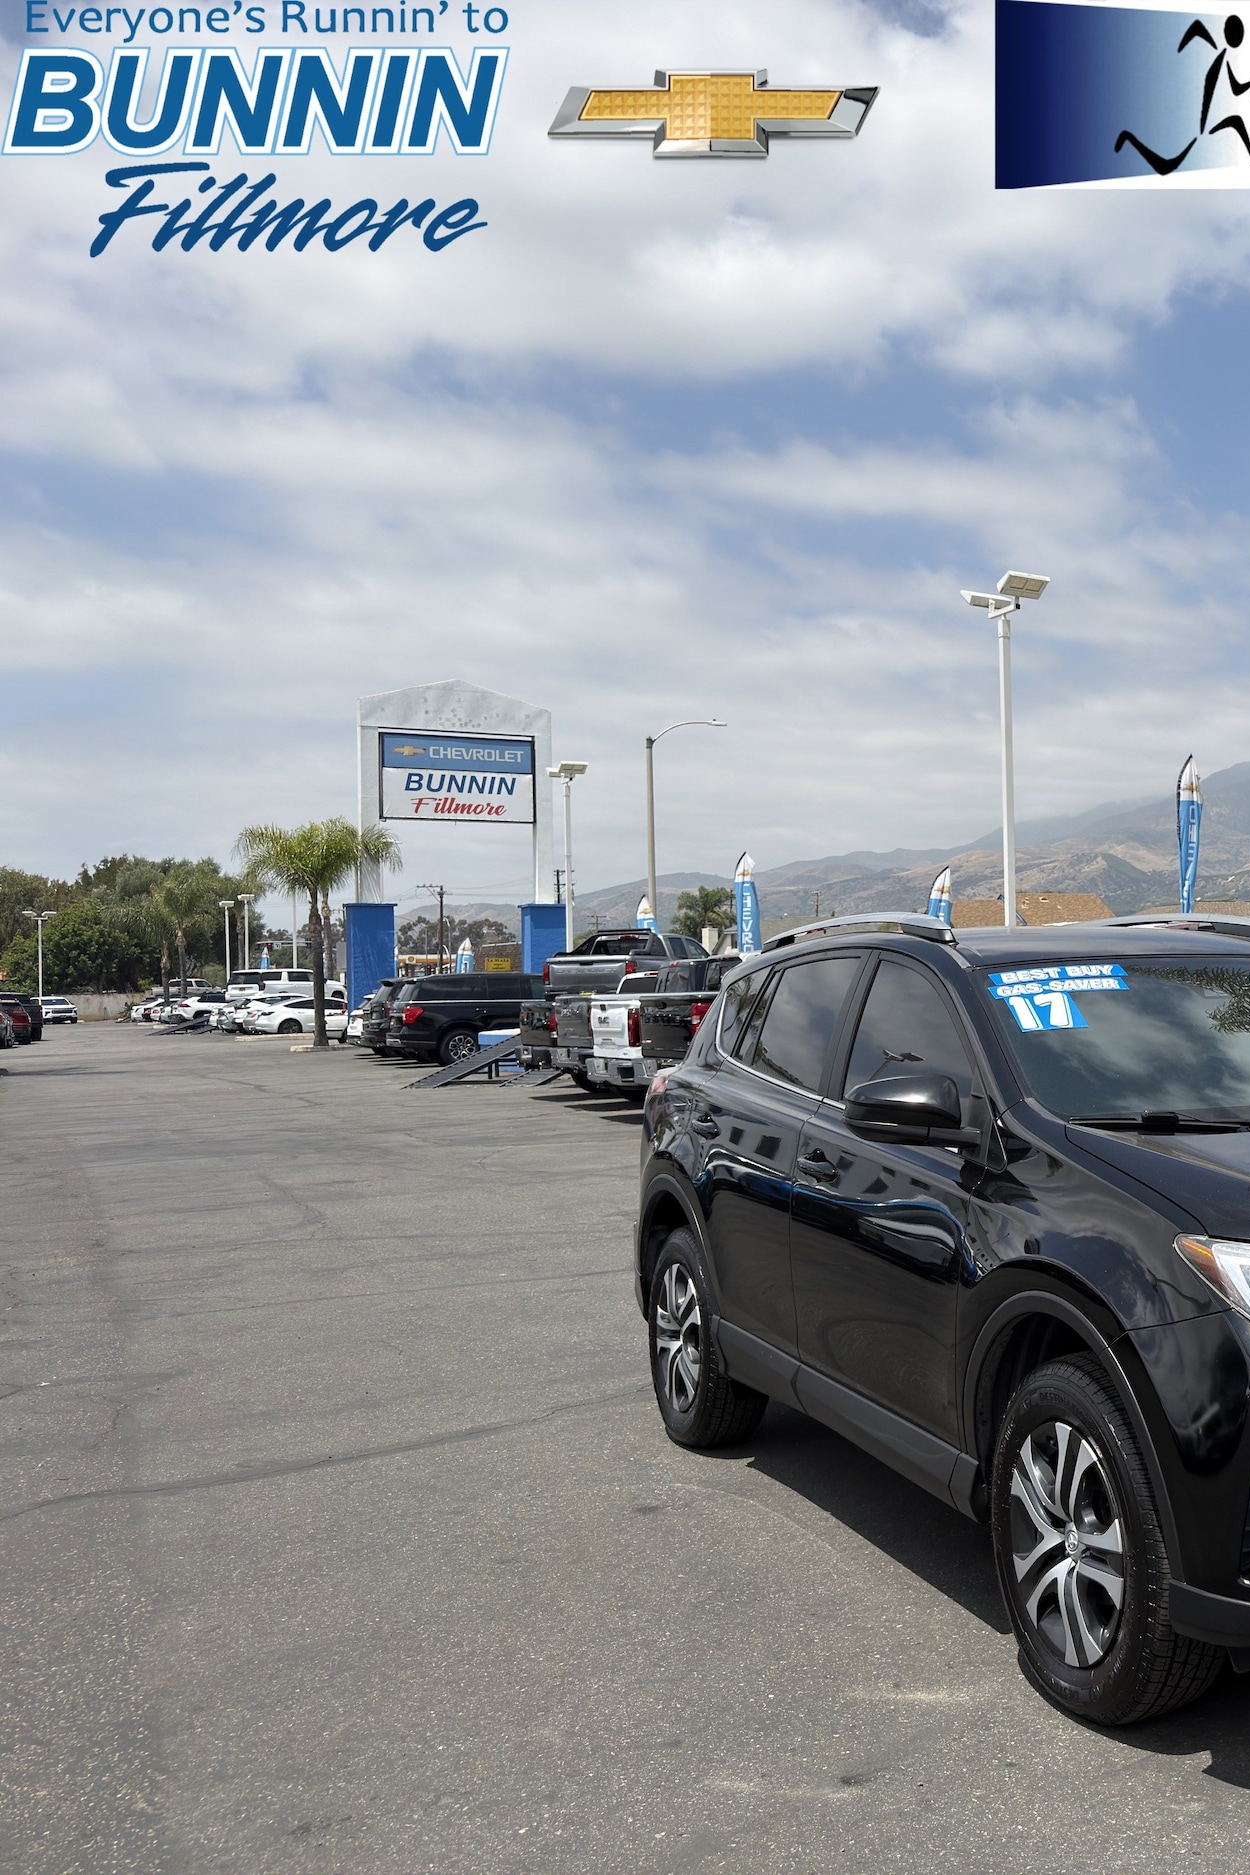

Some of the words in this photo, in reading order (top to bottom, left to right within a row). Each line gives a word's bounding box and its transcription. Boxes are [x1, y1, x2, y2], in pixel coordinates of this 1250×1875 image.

[429, 746, 524, 763] CHEVROLET
[404, 773, 516, 795] BUNNIN
[410, 797, 507, 816] Fillmore
[1000, 967, 1061, 984] BEST
[1065, 964, 1113, 978] BUY
[996, 978, 1120, 997] GAS-SAVER
[1008, 991, 1074, 1031] 17
